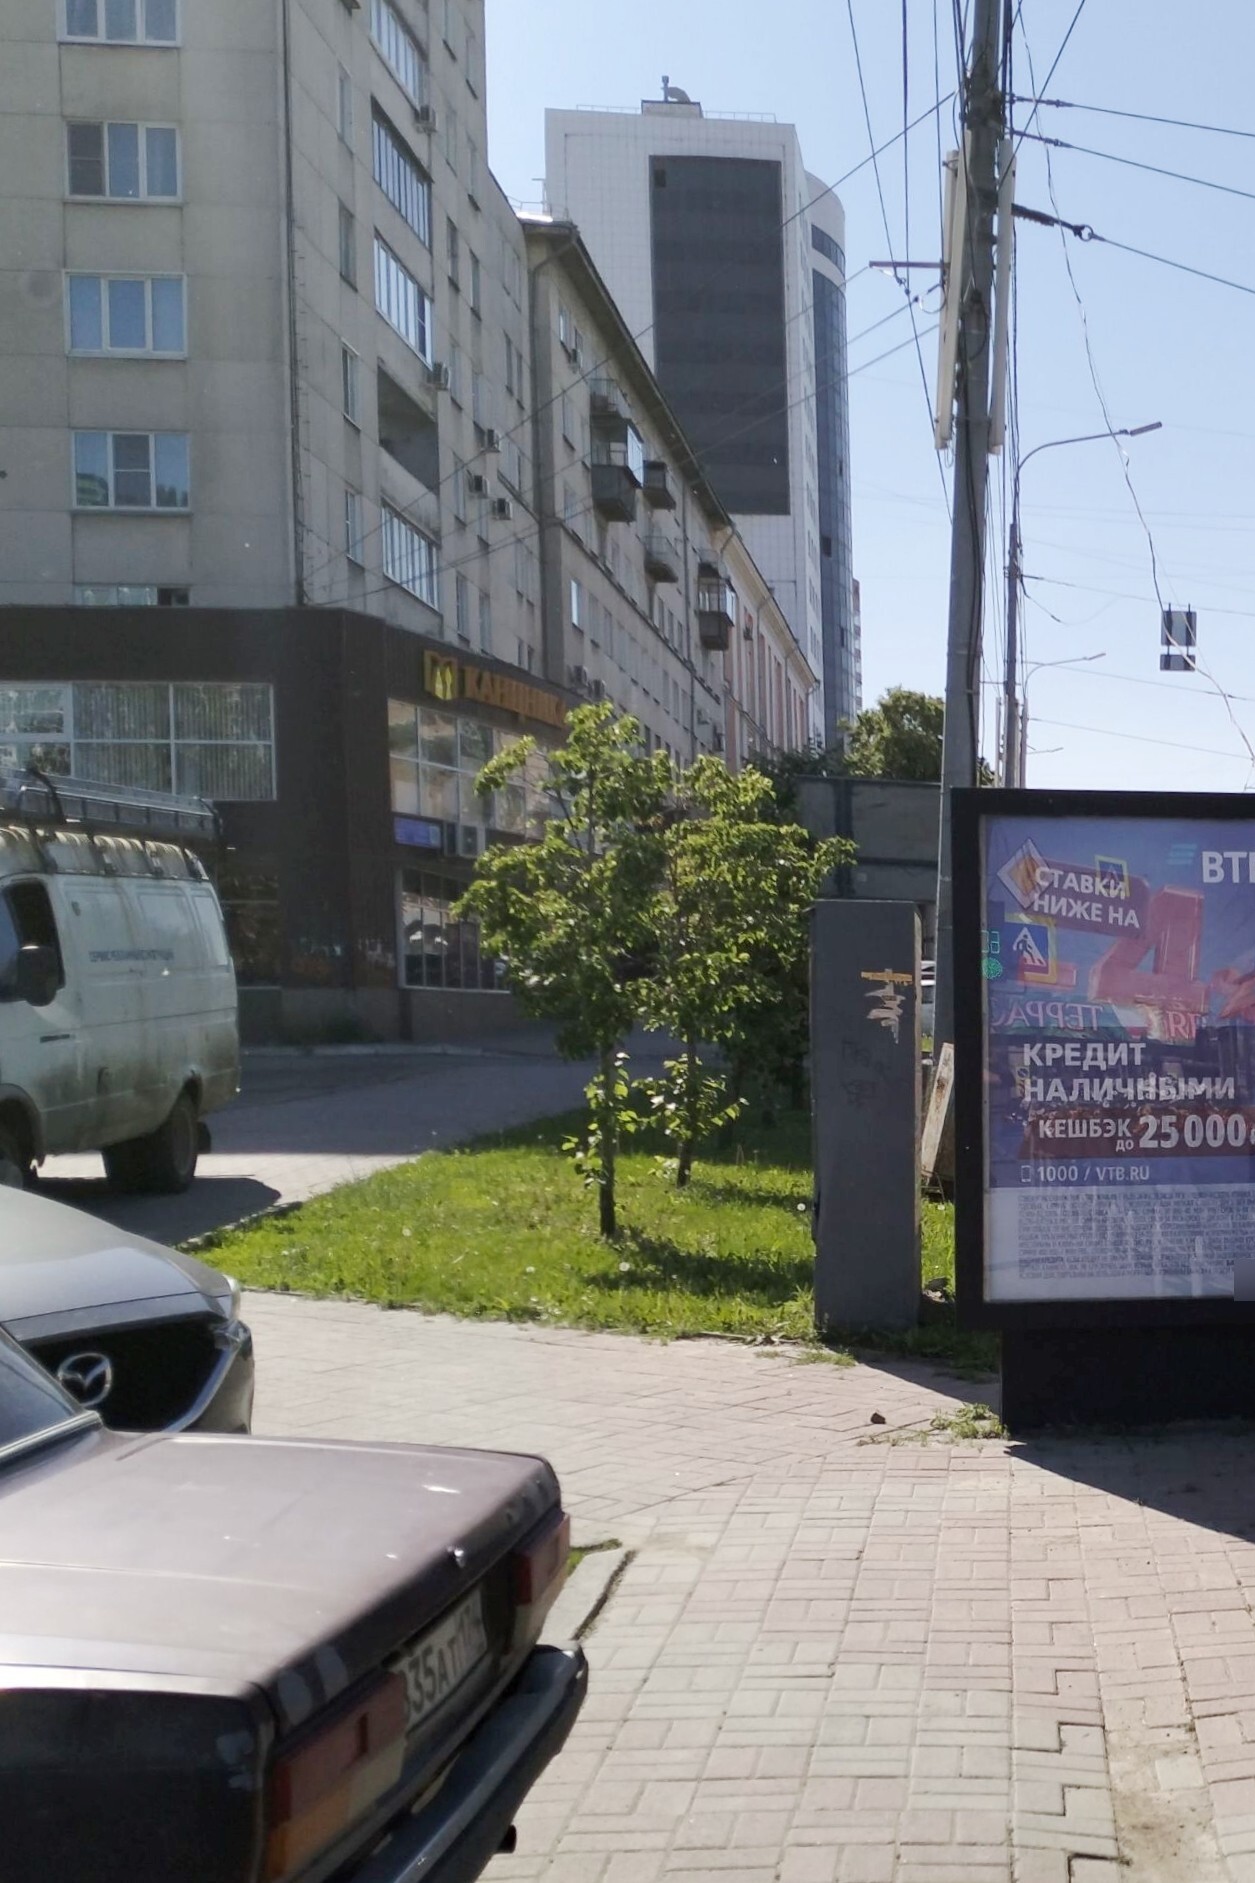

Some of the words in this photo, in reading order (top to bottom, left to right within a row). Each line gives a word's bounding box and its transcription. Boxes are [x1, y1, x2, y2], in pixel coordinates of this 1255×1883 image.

[1034, 866, 1127, 900] СТАВКИ
[1033, 893, 1102, 923] НИЖЕ
[1108, 907, 1140, 929] НА
[1023, 1043, 1146, 1070] КРЕДИТ
[1023, 1077, 1235, 1101] НАЛИЧНЫМИ
[1039, 1117, 1132, 1138] КЕШБЭК
[1037, 1166, 1078, 1181] 1000
[1095, 1166, 1150, 1181] VTB.RU
